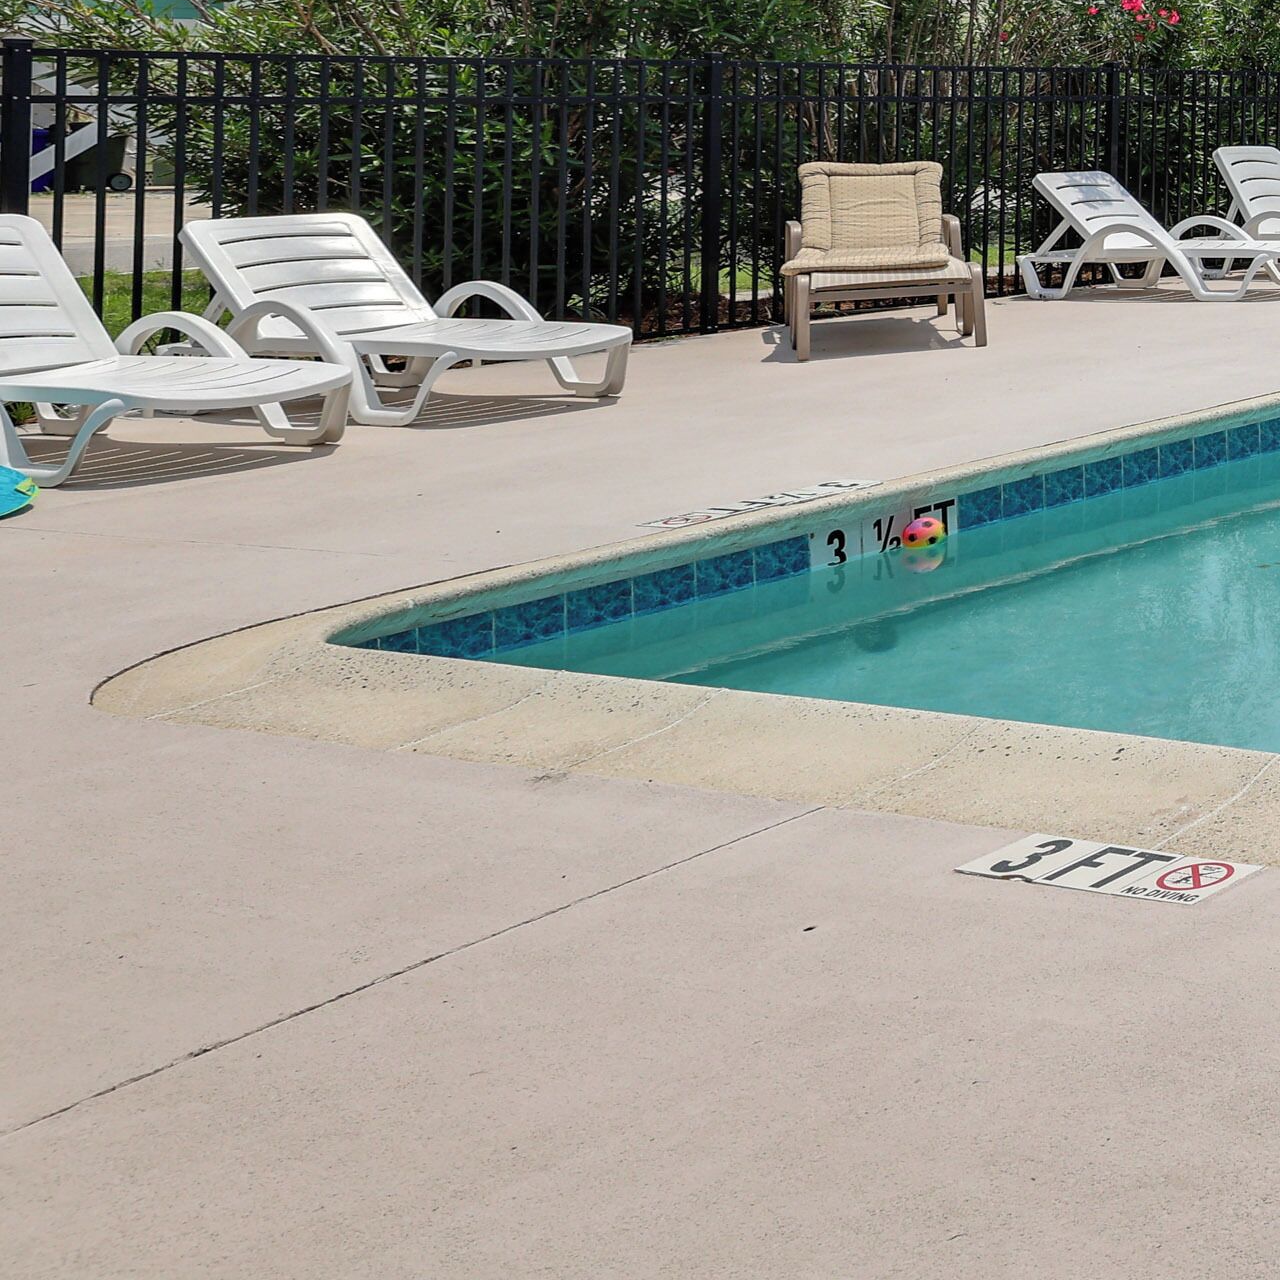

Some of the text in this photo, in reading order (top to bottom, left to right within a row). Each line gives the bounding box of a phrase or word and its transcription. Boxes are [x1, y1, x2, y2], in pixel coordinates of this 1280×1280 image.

[826, 529, 848, 567] 3
[990, 839, 1177, 888] 3 FT
[1120, 886, 1199, 902] NO DIVING
